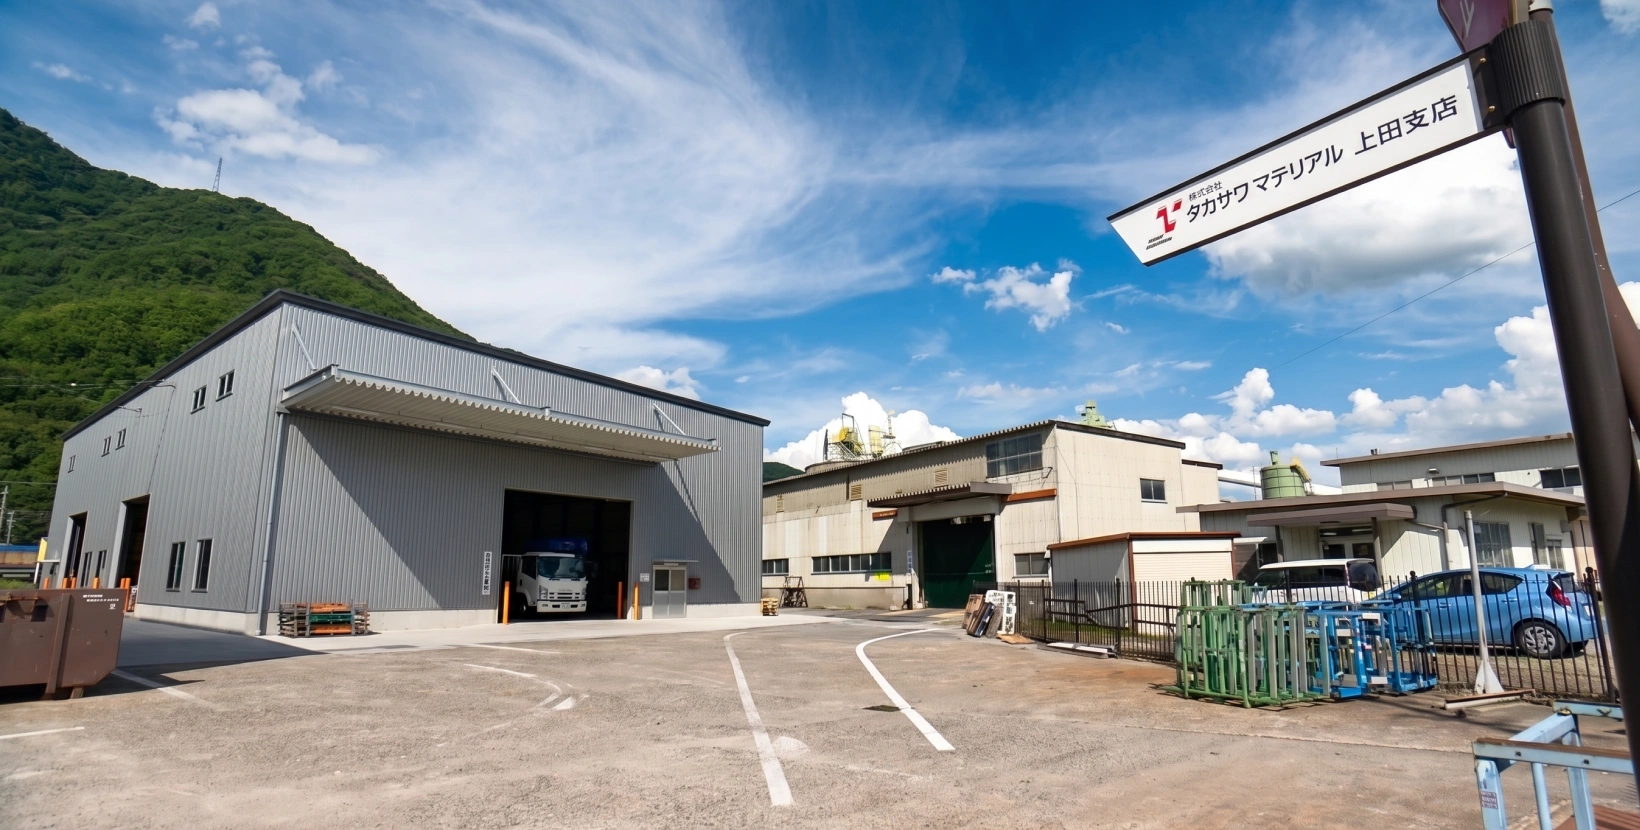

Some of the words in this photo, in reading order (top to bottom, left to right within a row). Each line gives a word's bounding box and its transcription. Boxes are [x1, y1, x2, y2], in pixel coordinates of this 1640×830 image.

[1354, 94, 1458, 155] 上田支店
[1188, 180, 1223, 202] 株式会社
